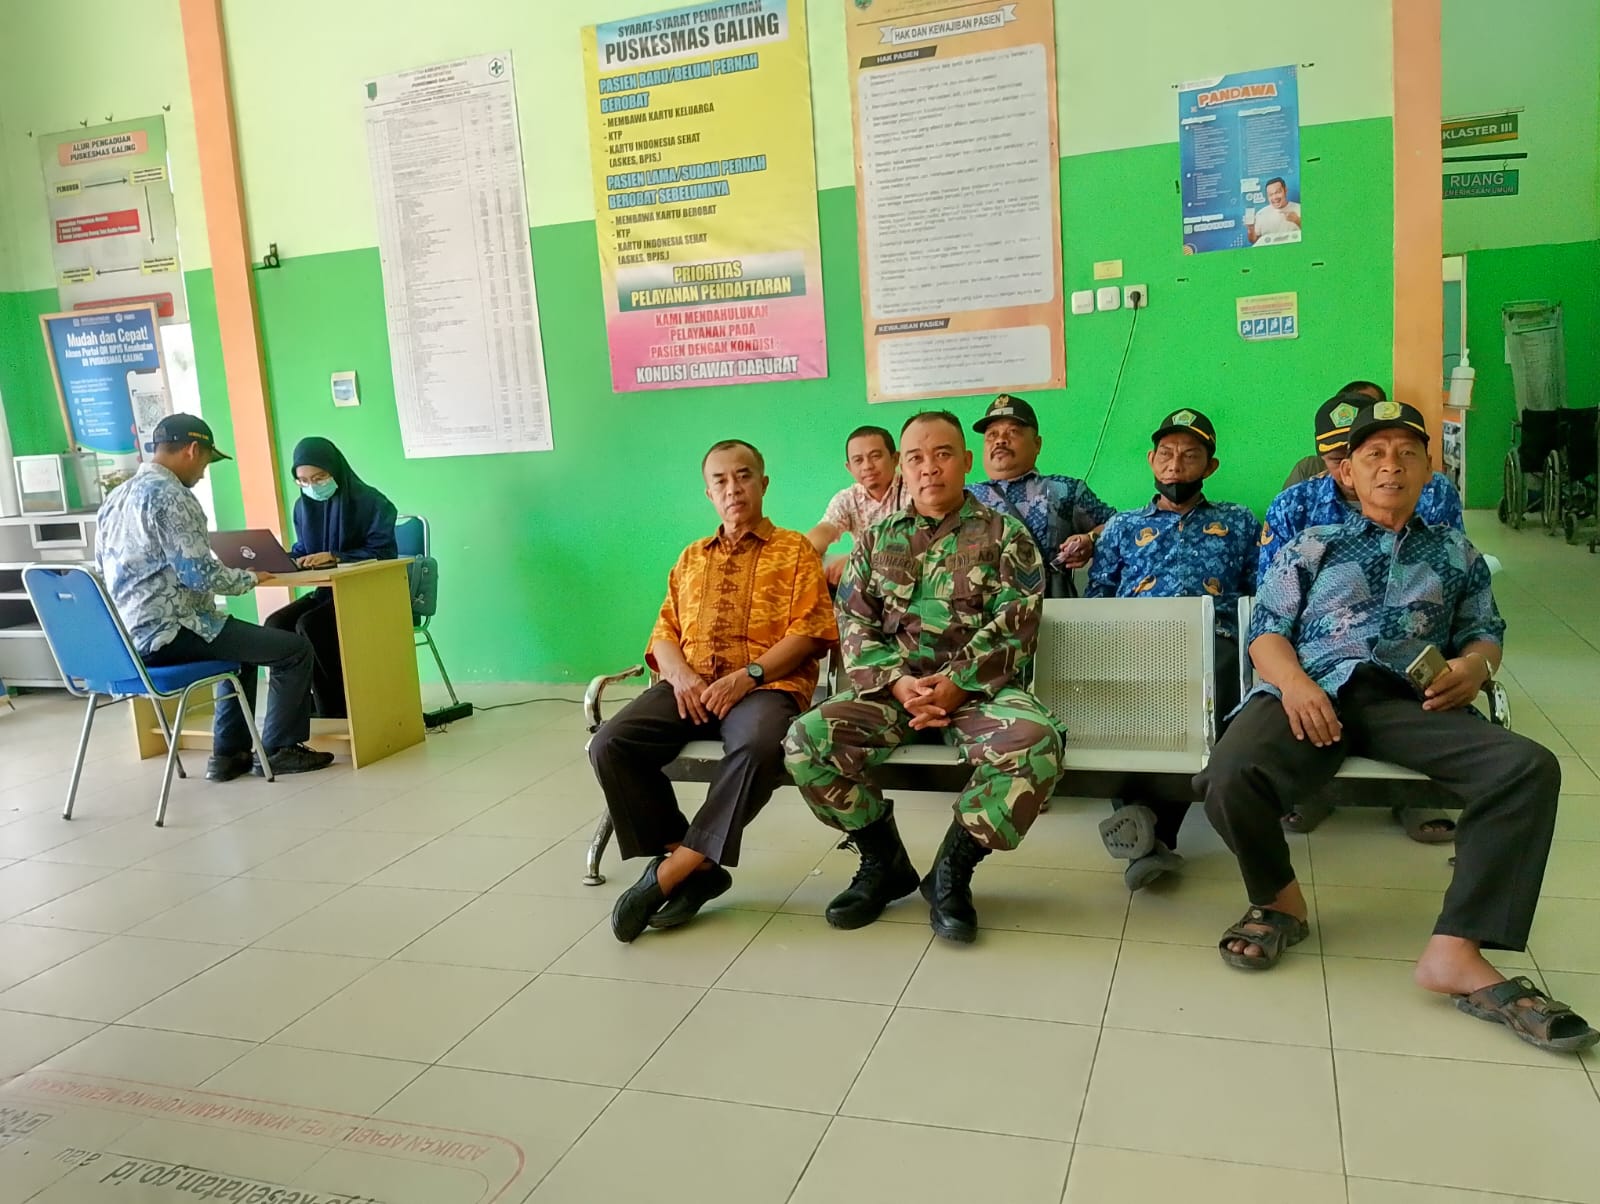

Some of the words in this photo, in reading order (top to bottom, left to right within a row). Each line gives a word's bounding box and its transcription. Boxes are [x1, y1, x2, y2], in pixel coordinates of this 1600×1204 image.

[618, 12, 690, 37] SYARAT-SYARAT
[693, 0, 763, 25] PENDAFTARAN
[894, 30, 910, 40] HAK
[911, 27, 927, 38] DAN
[928, 19, 972, 35] KEWAJIBAN
[973, 14, 1001, 28] PASIEN
[605, 25, 710, 64] PUSKESMAS
[714, 12, 780, 45] GALING
[893, 50, 920, 61] PASIEN
[599, 73, 638, 95] PASIEN
[638, 61, 712, 89] BARU/BELUM
[713, 52, 759, 76] PERNAH
[600, 92, 650, 114] BEROBAT
[1198, 83, 1276, 107] PANDAWA
[607, 111, 647, 128] MEMBAWA
[649, 108, 674, 122] KARTU
[675, 102, 715, 118] KELUARGA
[608, 130, 623, 141] KTP
[1442, 124, 1498, 140] KLASTER
[1500, 122, 1513, 132] III
[70, 147, 110, 161] PUSKESMAS
[111, 143, 136, 154] GALING
[72, 142, 90, 152] ALUR
[91, 135, 131, 147] PENGADUAN
[609, 143, 634, 155] KARTU
[635, 135, 676, 150] INDONESIA
[677, 132, 701, 145] SEHAT
[606, 171, 645, 191] PASIEN
[646, 161, 720, 186] LAMA/SUDAH
[721, 154, 767, 176] PERNAH
[1450, 172, 1504, 187] RUANG
[608, 189, 657, 210] BEROBAT
[658, 180, 731, 204] SEBELUMNYA
[1444, 188, 1491, 197] EMERIKSAAN
[615, 212, 654, 226] MEMBAWA
[655, 209, 682, 221] KARTU
[682, 204, 717, 218] BEROBAT
[616, 228, 631, 239] KTP
[617, 240, 642, 252] KARTU
[643, 235, 683, 249] INDONESIA
[684, 232, 708, 244] SEHAT
[673, 260, 743, 284] PRIORITAS
[631, 285, 699, 307] PELAYANAN
[702, 276, 792, 301] PENDAFTARAN
[655, 313, 682, 327] KAMI
[684, 304, 769, 325] MENDAHULUKAN
[919, 319, 945, 329] PASIEN
[66, 331, 98, 348] Mudah
[99, 329, 117, 345] dan
[117, 325, 149, 345] Cepat!
[670, 325, 726, 342] PELAYANAN
[729, 322, 756, 337] PADA
[651, 344, 686, 359] PASIEN
[688, 341, 728, 356] DENGAN
[730, 338, 775, 352] KONDISI
[636, 364, 688, 384] KONDISI
[690, 360, 736, 380] GAWAT
[737, 356, 799, 376] DARURAT
[407, 1135, 491, 1160] ADUKAN
[98, 1159, 376, 1204] -kesehatan.go.id
